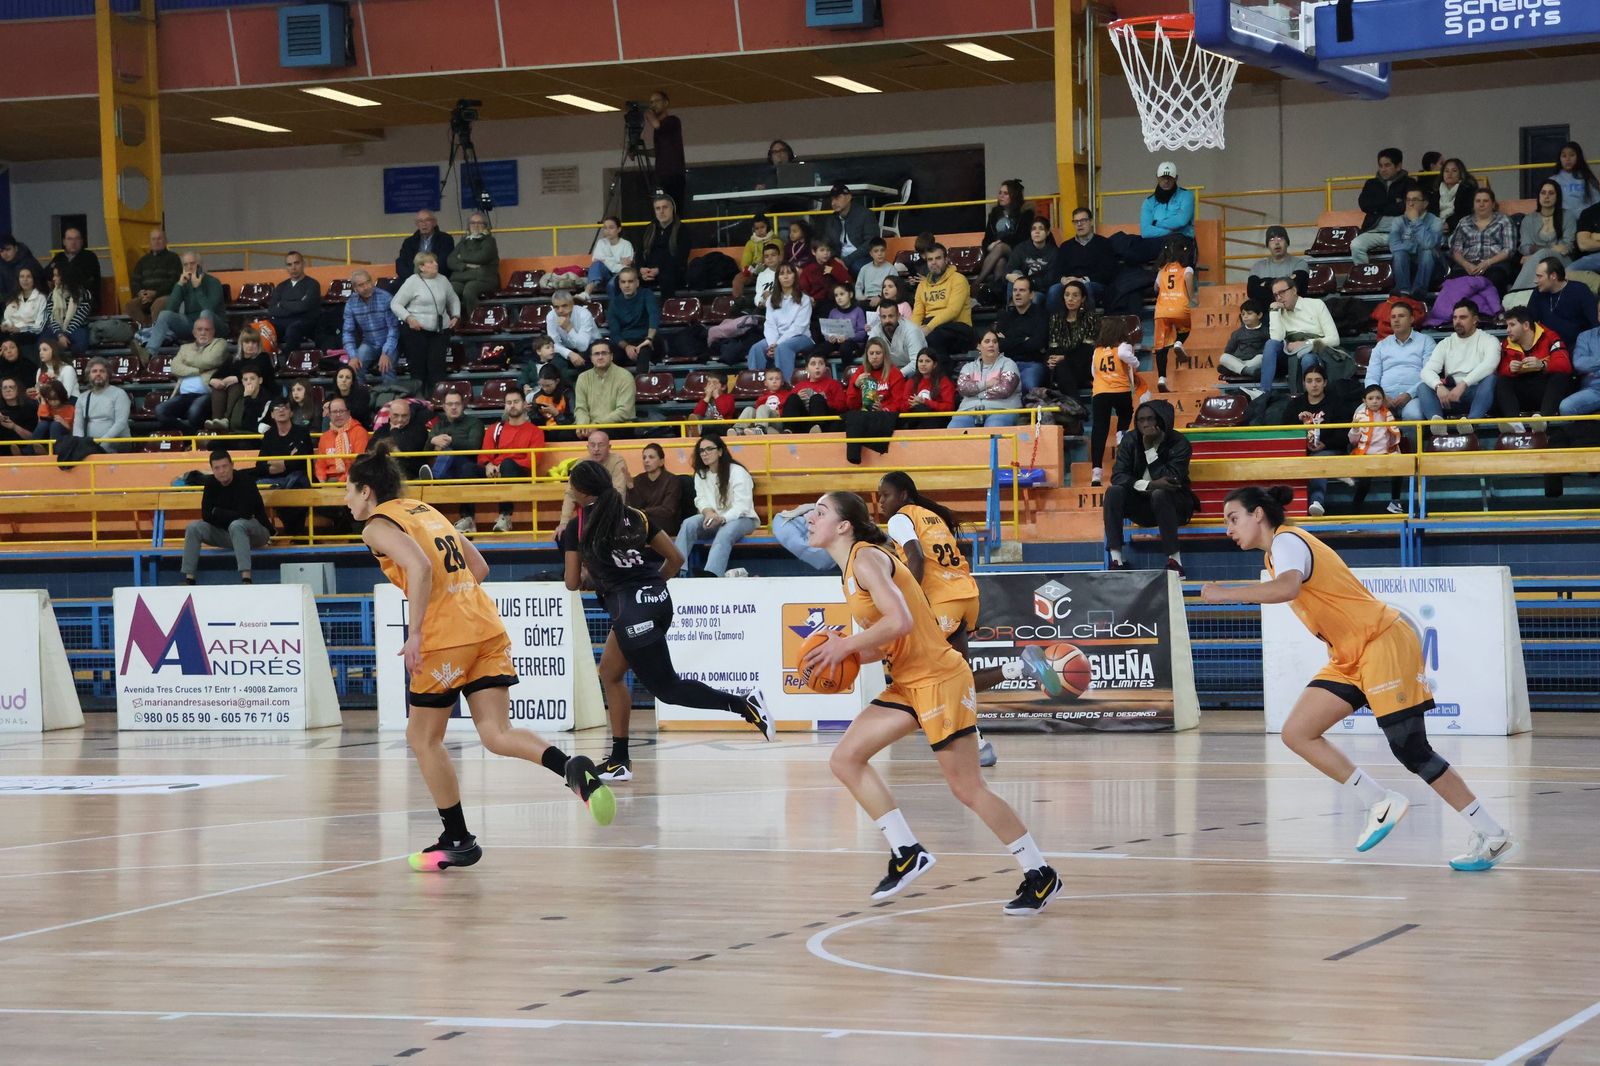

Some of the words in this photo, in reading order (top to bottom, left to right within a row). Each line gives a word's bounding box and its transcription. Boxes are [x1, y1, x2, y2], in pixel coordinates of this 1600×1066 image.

[1445, 9, 1561, 39] Sports
[1331, 229, 1347, 240] 27
[1167, 274, 1176, 290] 5
[679, 301, 687, 311] 7
[1100, 356, 1115, 373] 45
[434, 535, 466, 574] 28
[1409, 577, 1456, 592] INDUSTRIAL
[525, 598, 563, 617] FELIPE
[677, 605, 708, 614] CAMINO
[710, 605, 719, 614] DE
[721, 605, 731, 614] LA
[733, 604, 756, 613] PLATA
[681, 618, 694, 628] 980
[695, 618, 708, 628] 570
[709, 618, 721, 628] 021
[524, 624, 564, 646] GÓMEZ
[687, 630, 697, 641] del
[698, 630, 713, 640] Vino
[714, 630, 745, 641] (Zamora)
[1091, 650, 1155, 680] SUEÑA
[700, 672, 706, 681] A
[708, 672, 748, 681] DOMICILIO
[749, 672, 760, 681] DE
[1090, 680, 1107, 689] SIN
[1110, 680, 1155, 689] LIMITES
[144, 698, 290, 708] marianandresasesoria@gmail.com
[509, 700, 567, 720] BOGADO
[1055, 711, 1101, 720] EQUIPOS
[144, 713, 163, 723] 980
[166, 713, 179, 723] 05
[182, 713, 195, 723] 85
[198, 713, 211, 723] 90
[221, 713, 241, 723] 605
[244, 713, 257, 723] 76
[260, 713, 273, 723] 71
[276, 713, 290, 723] 05
